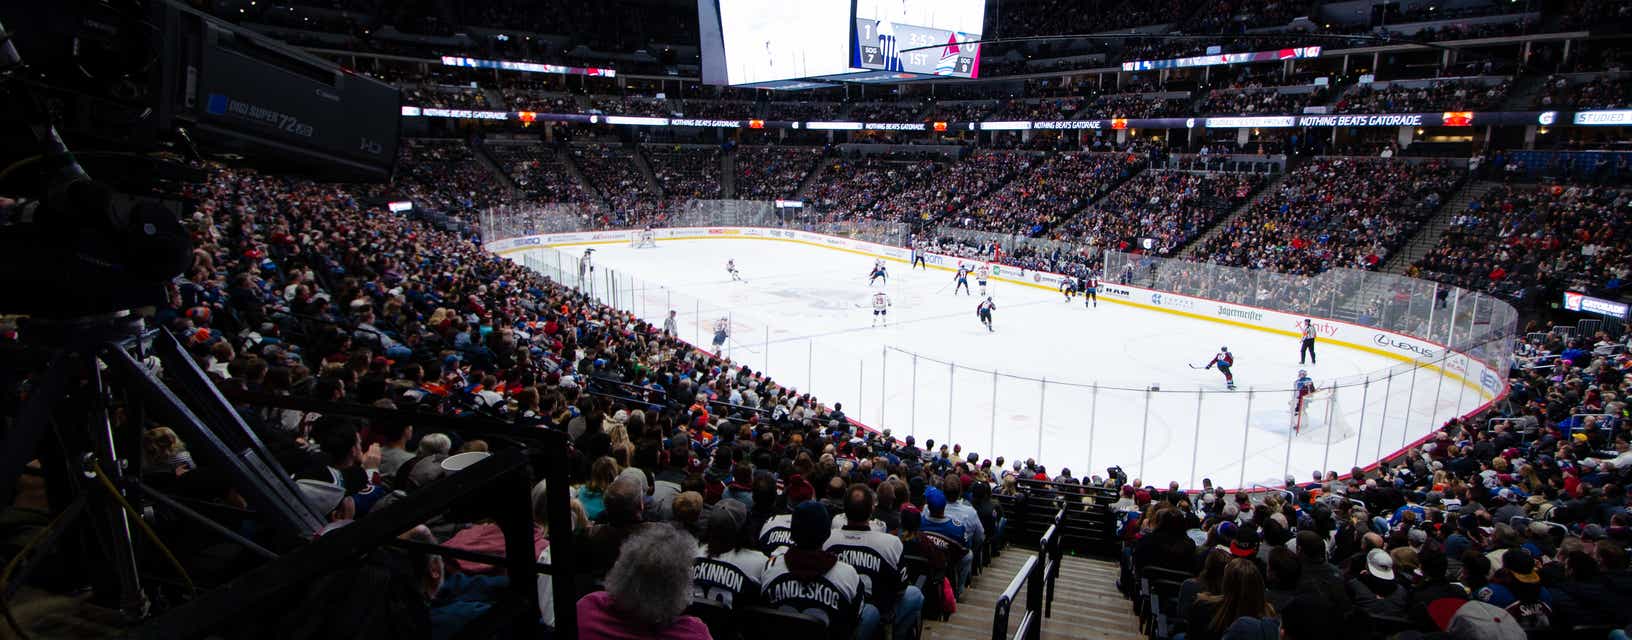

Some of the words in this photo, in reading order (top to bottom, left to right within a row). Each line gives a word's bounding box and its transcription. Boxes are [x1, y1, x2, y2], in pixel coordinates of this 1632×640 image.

[868, 54, 874, 63] 7
[909, 53, 929, 66] 1ST
[1034, 121, 1055, 130] NOTHING
[1055, 121, 1072, 130] BEATS
[1299, 117, 1337, 127] NOTHING
[1337, 116, 1367, 126] BEATS
[1296, 319, 1338, 337] xnity
[1391, 341, 1434, 359] LEXUS
[767, 580, 839, 610] LANDESKOG
